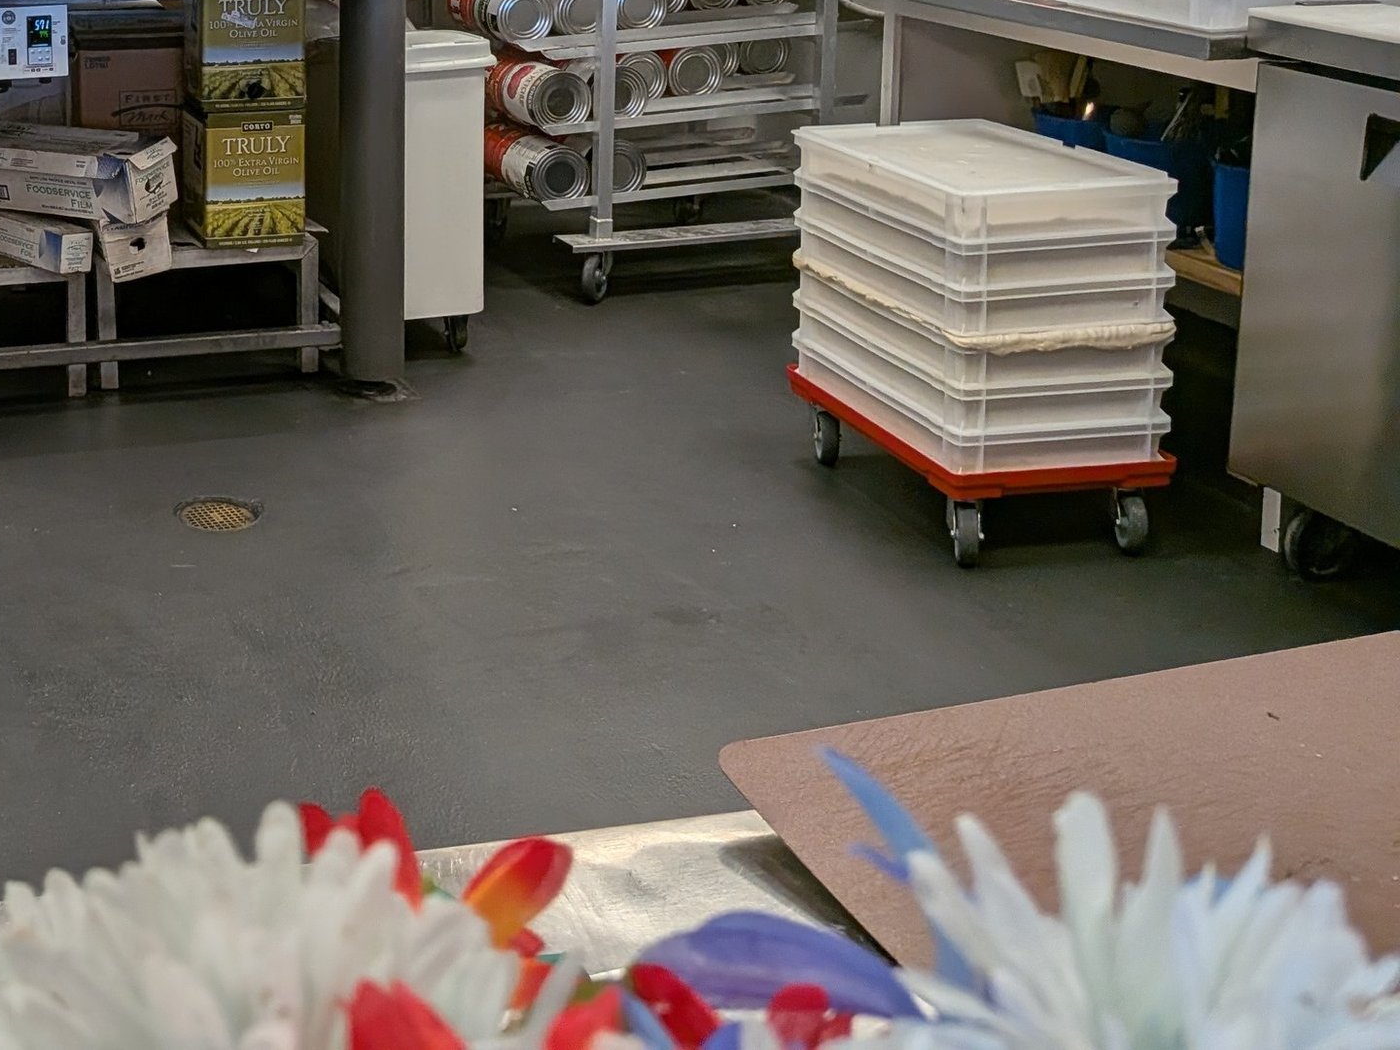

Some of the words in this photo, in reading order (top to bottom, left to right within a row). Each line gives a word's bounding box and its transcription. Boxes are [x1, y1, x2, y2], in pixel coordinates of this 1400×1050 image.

[265, 18, 299, 28] VIRGIN
[229, 30, 258, 38] OLIVE
[260, 29, 278, 37] OIL
[125, 94, 170, 103] FIRST
[243, 123, 271, 131] CORTO
[222, 135, 291, 155] TRULY
[238, 158, 267, 167] EXTRA
[268, 156, 299, 165] VIRGIN
[232, 167, 260, 177] OLIVE
[263, 166, 280, 175] OIL
[26, 183, 92, 199] FOODSERVICE
[70, 198, 94, 210] FILM
